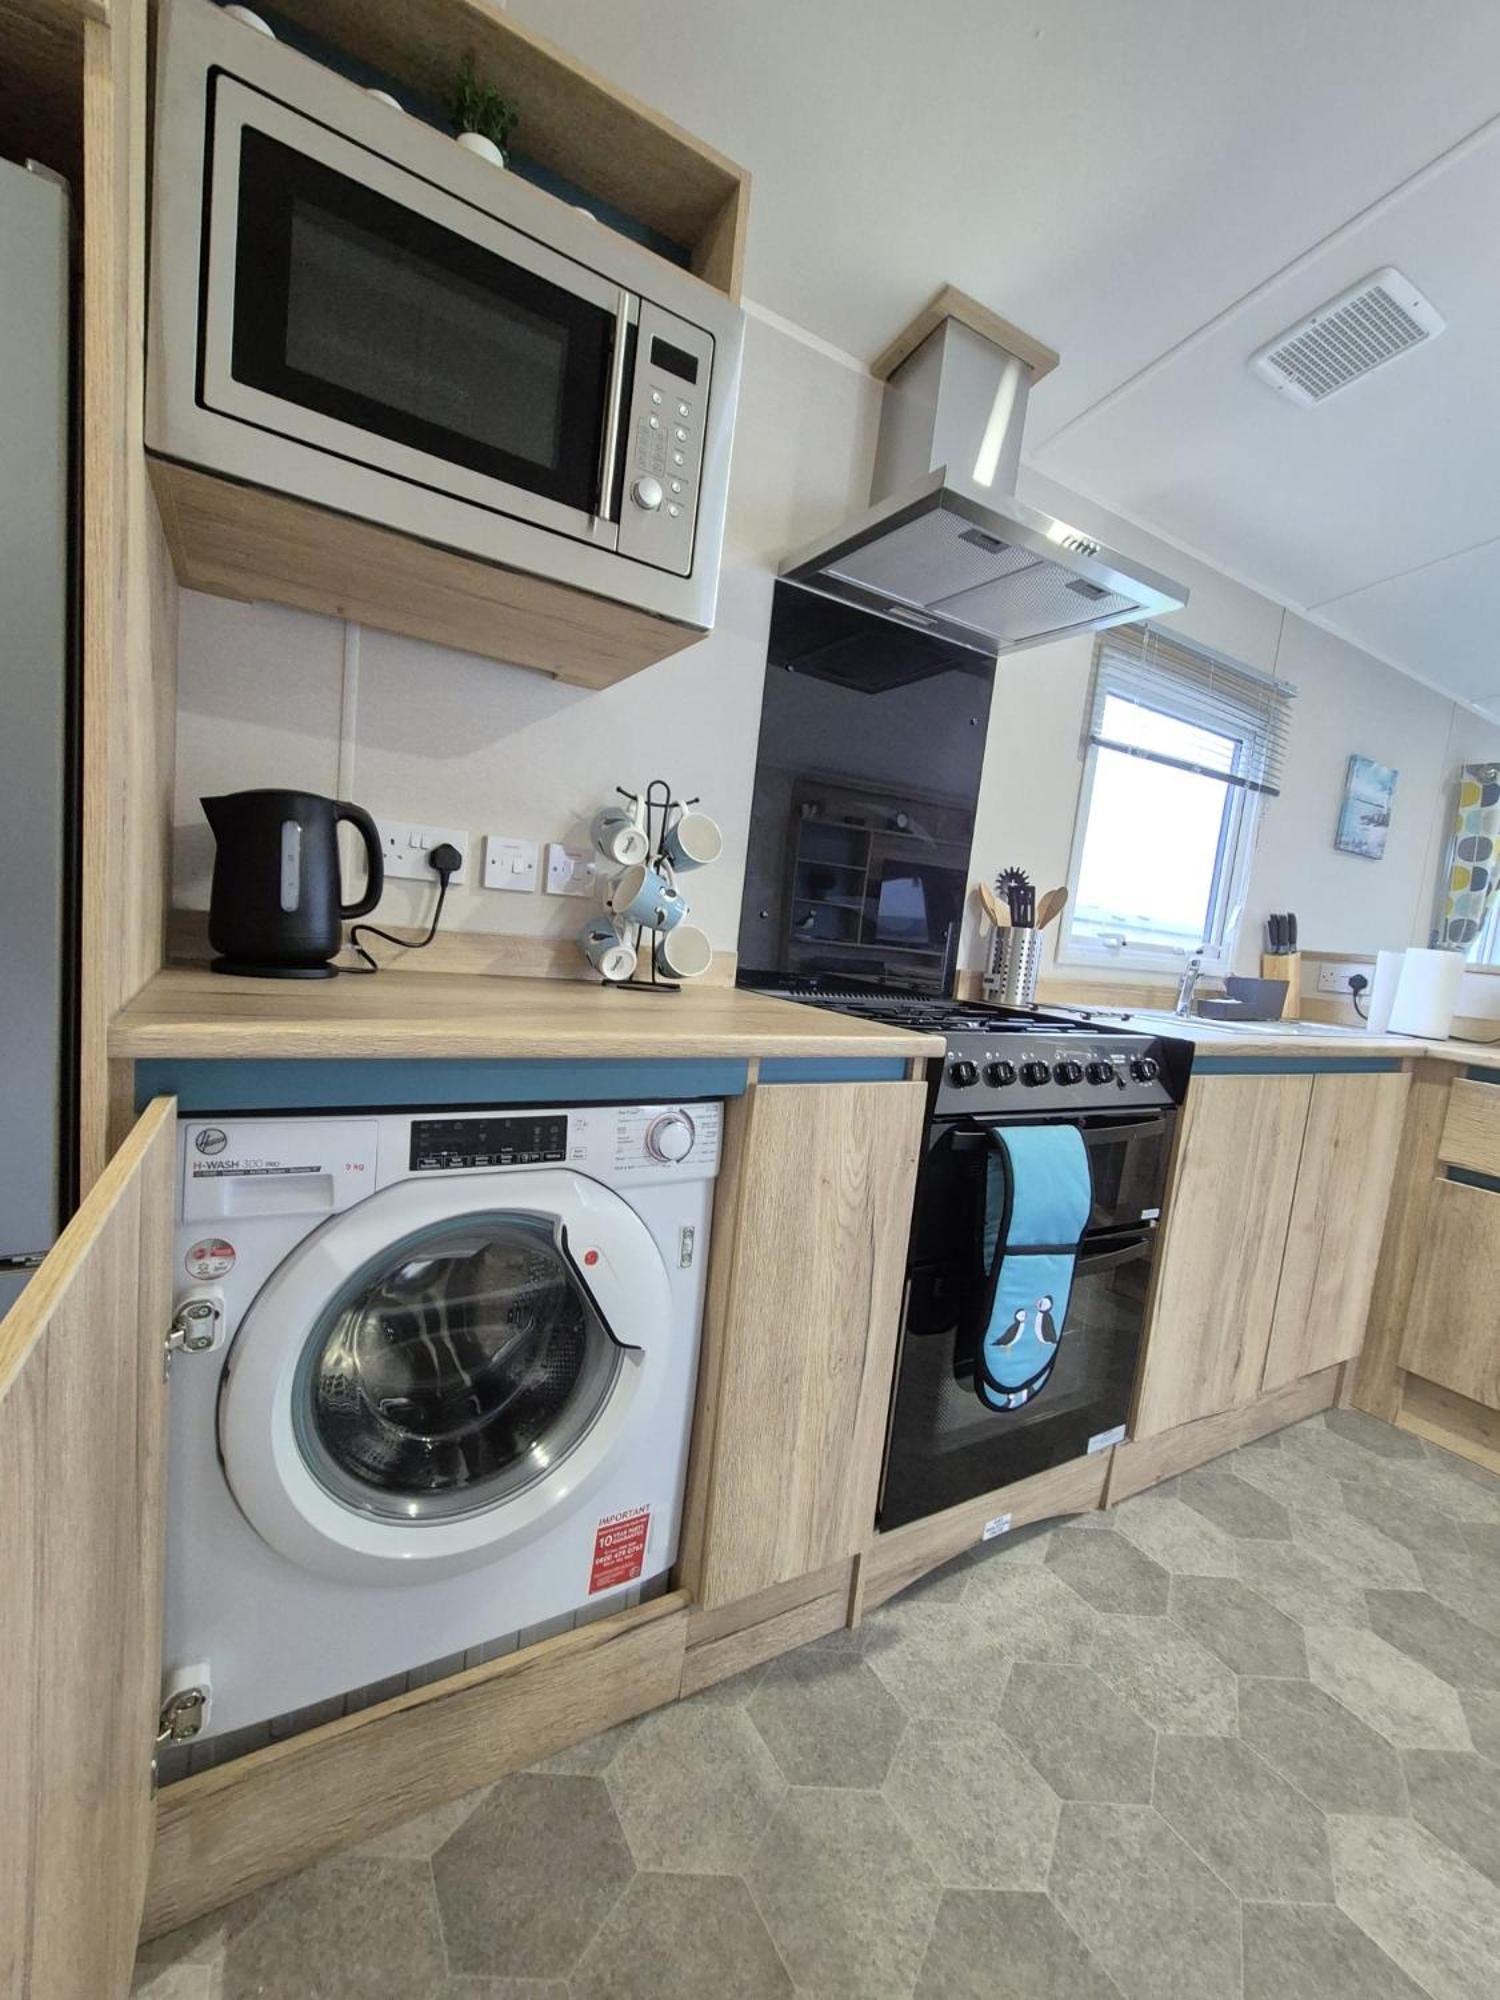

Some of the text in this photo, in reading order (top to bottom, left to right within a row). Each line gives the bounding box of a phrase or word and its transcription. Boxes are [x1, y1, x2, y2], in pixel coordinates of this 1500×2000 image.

[193, 1160, 239, 1170] H-WASH
[241, 1160, 263, 1169] 300
[599, 1503, 650, 1525] IMPORTANT
[600, 1535, 613, 1548] 10
